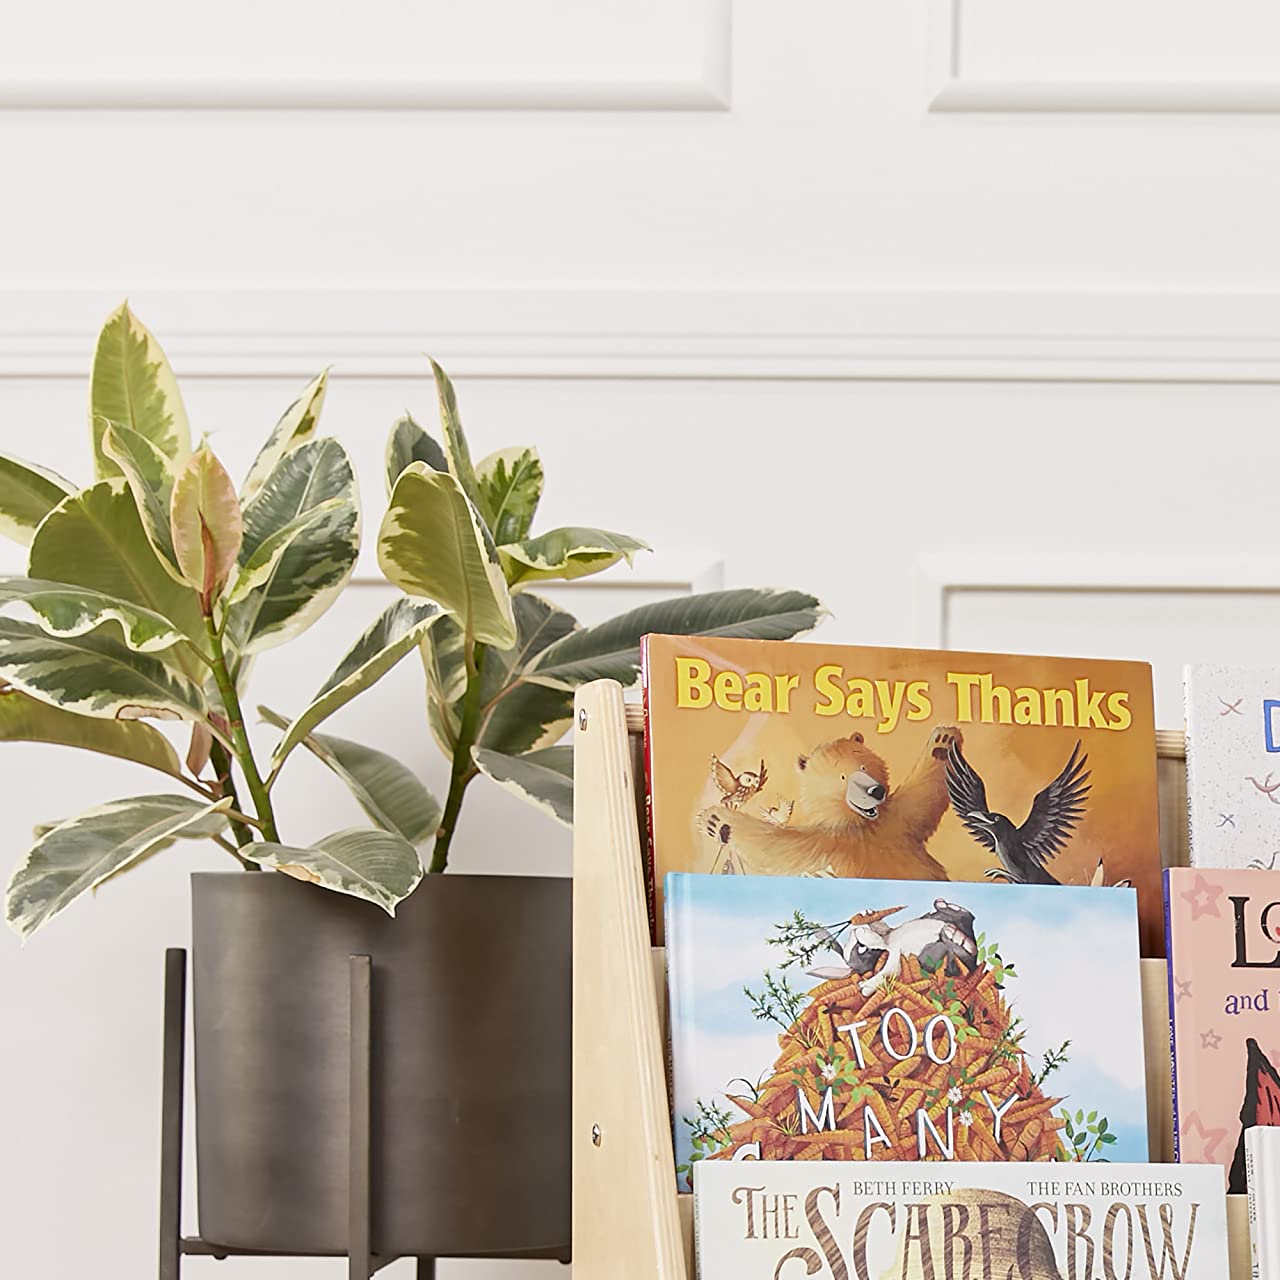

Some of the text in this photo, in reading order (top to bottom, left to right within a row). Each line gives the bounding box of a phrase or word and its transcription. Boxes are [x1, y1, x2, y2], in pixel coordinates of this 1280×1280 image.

[674, 657, 799, 714] Bear
[813, 666, 931, 734] Says
[947, 672, 1132, 731] Thanks
[1225, 988, 1269, 1017] and
[837, 1007, 957, 1070] TOO
[797, 1086, 1020, 1160] MANY
[853, 1181, 954, 1197] BETH FERRY
[1026, 1181, 1183, 1197] THE FAN BROTHERS
